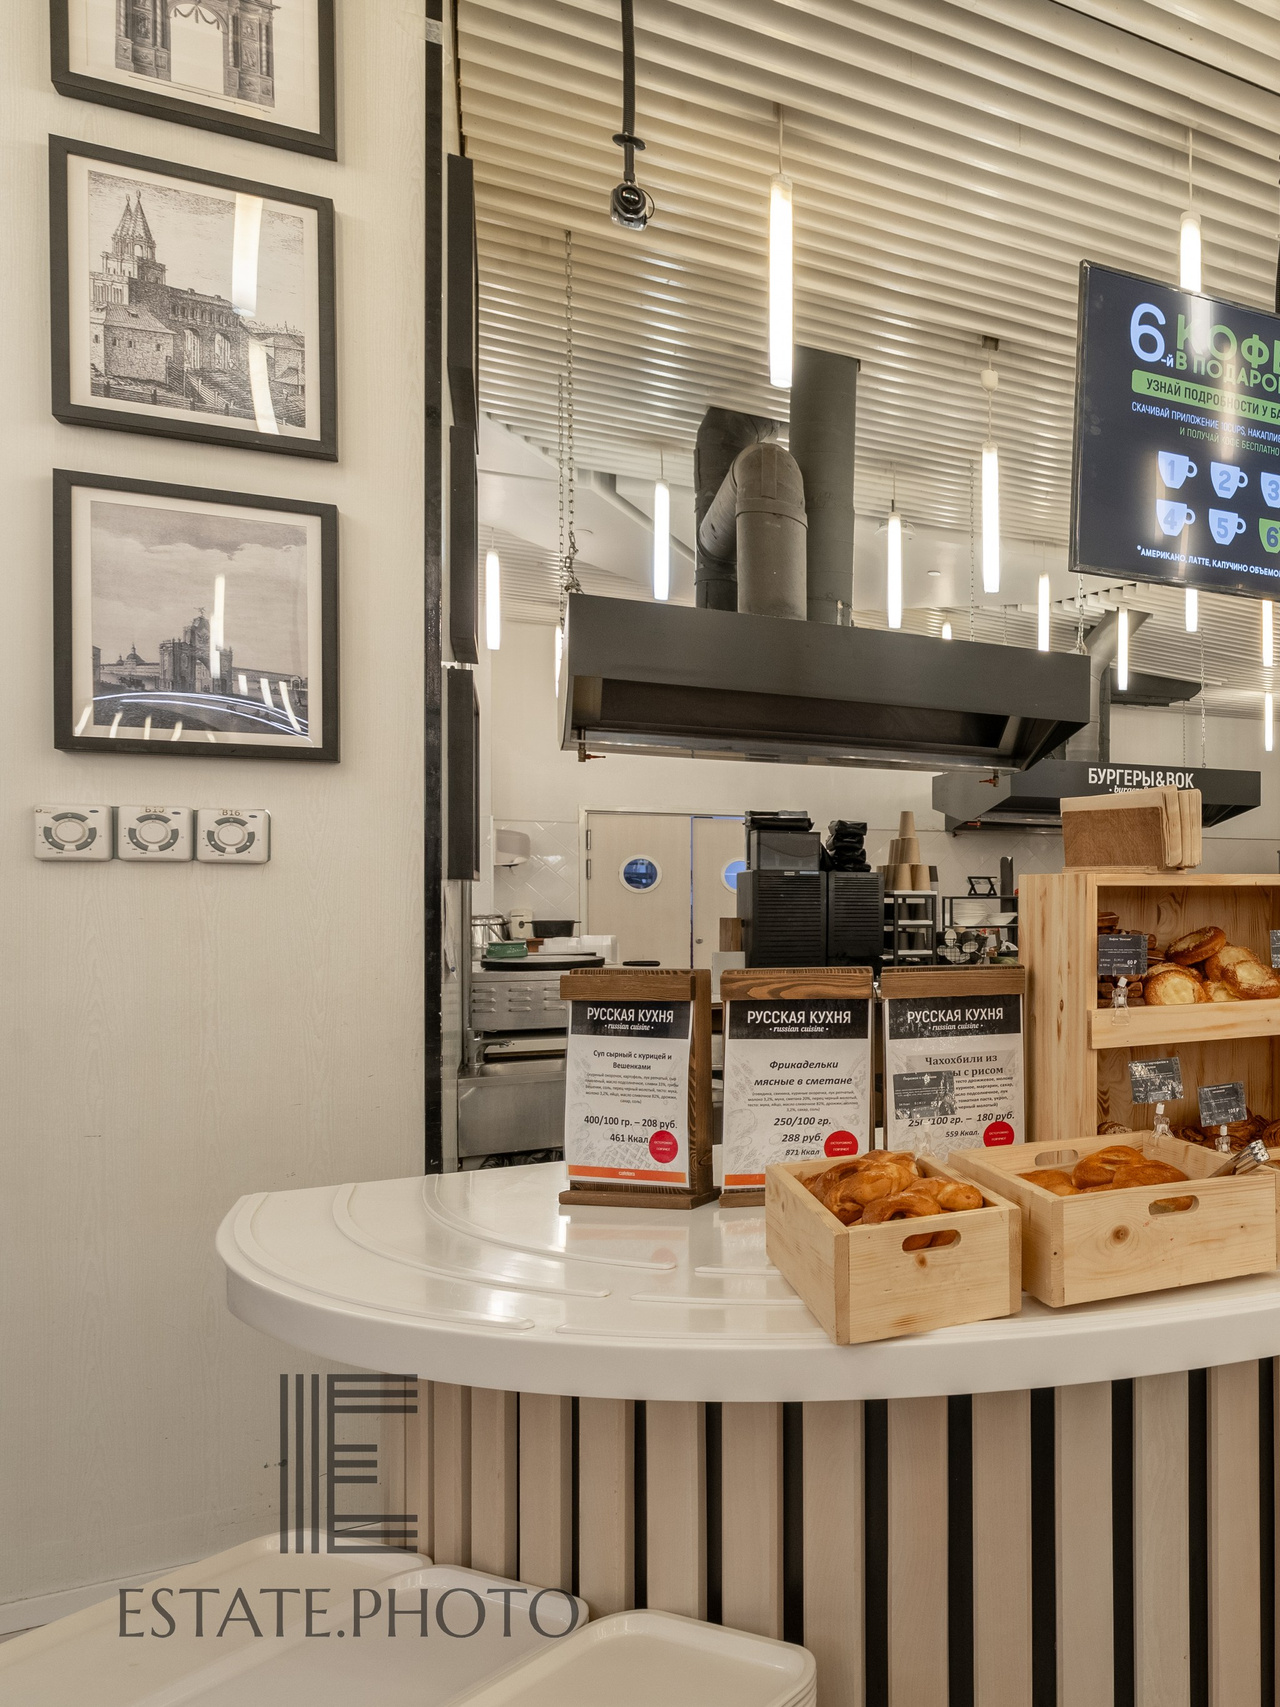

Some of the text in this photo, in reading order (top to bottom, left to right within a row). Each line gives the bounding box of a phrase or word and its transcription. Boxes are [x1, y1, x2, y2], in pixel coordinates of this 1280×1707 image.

[1176, 350, 1188, 371] В
[1146, 377, 1181, 397] УЗНАЙ
[1184, 386, 1259, 416] ПОДРОБНОСТИ
[1261, 406, 1269, 417] У
[1131, 401, 1170, 419] СКАЧИВАЙ
[1171, 409, 1219, 430] ПРИЛОЖЕНИЕ
[1179, 427, 1185, 436] И
[1187, 428, 1219, 443] ПОЛУЧАЙ
[1241, 437, 1280, 456] БЕСПЛАТНО
[1167, 459, 1176, 481] 1
[1218, 470, 1232, 492] 2
[1267, 480, 1280, 501] 3
[1163, 508, 1178, 530] 4
[1216, 517, 1229, 539] 5
[1188, 555, 1211, 568] ЛАТТЕ,
[1212, 560, 1248, 573] КАПУЧИНО
[1088, 767, 1195, 789] БУРГЕРЫ&ВОК
[587, 1007, 674, 1023] РУССКАЯ КУХНЯ
[747, 1010, 852, 1024] РУССКАЯ КУХНЯ
[907, 1008, 1004, 1024] РУССКАЯ КУХНЯ
[630, 1023, 651, 1031] cuisine
[606, 1051, 632, 1059] сырный
[638, 1053, 666, 1061] курицей
[925, 1056, 984, 1066] Чахохбили
[612, 1062, 652, 1070] Вешенками
[769, 1060, 839, 1071] Фрикадельки
[971, 1067, 1004, 1077] рисом
[805, 1077, 853, 1086] сметане
[584, 1115, 619, 1126] 400/100
[621, 1120, 632, 1128] гр.
[642, 1118, 658, 1127] 208
[660, 1120, 678, 1130] руб.
[774, 1117, 832, 1127] 250/100 гр.
[976, 1112, 994, 1122] 180
[995, 1110, 1015, 1122] руб.
[610, 1134, 626, 1142] 461
[782, 1132, 824, 1144] 288 руб.
